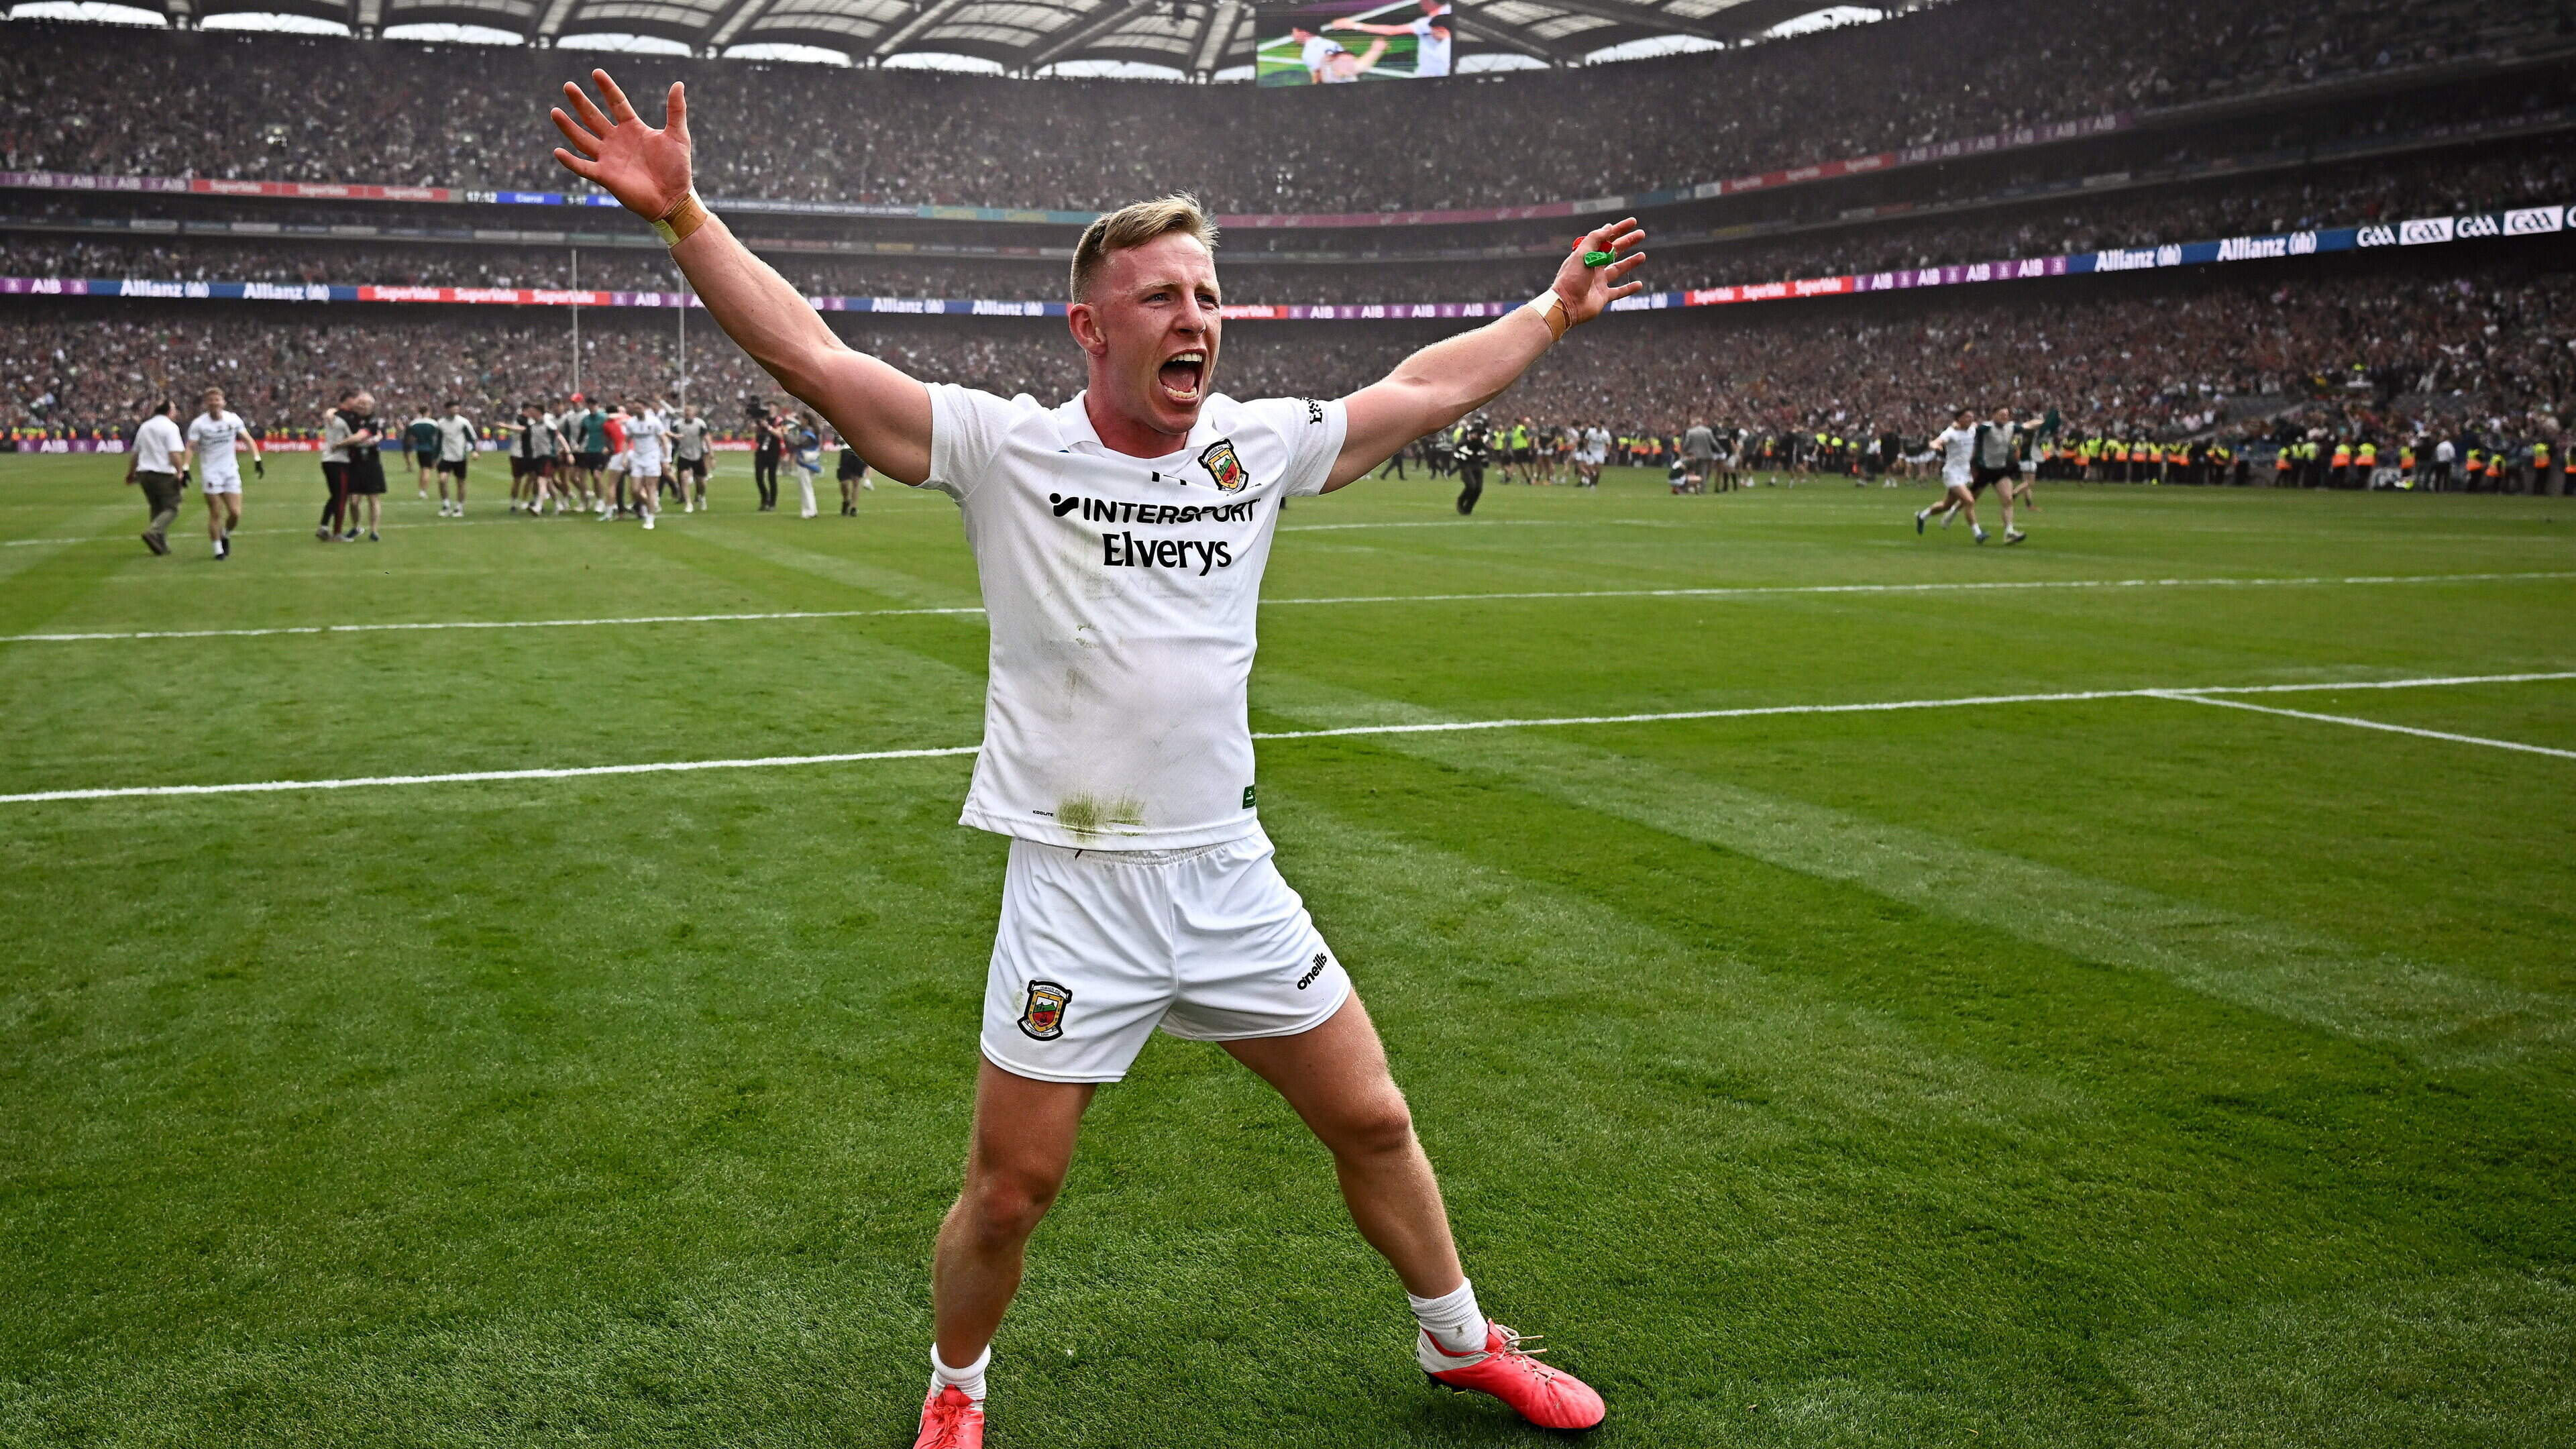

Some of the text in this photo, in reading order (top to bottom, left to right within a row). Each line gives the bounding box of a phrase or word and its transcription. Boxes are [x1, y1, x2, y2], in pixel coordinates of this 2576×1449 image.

[2094, 237, 2286, 272] Allianz Allianz
[1872, 258, 2043, 290] AIB AIB AIB AIB
[32, 278, 62, 294] AIB
[120, 279, 305, 300] Allianz Allianz
[635, 292, 661, 307] AIB
[871, 297, 1022, 316] Allianz Allianz
[1310, 303, 1485, 319] AIB AIB AIB AIB
[40, 438, 124, 453] AIB AIB
[1083, 498, 1258, 524] INTERSPORT
[1102, 531, 1232, 576] Elverys
